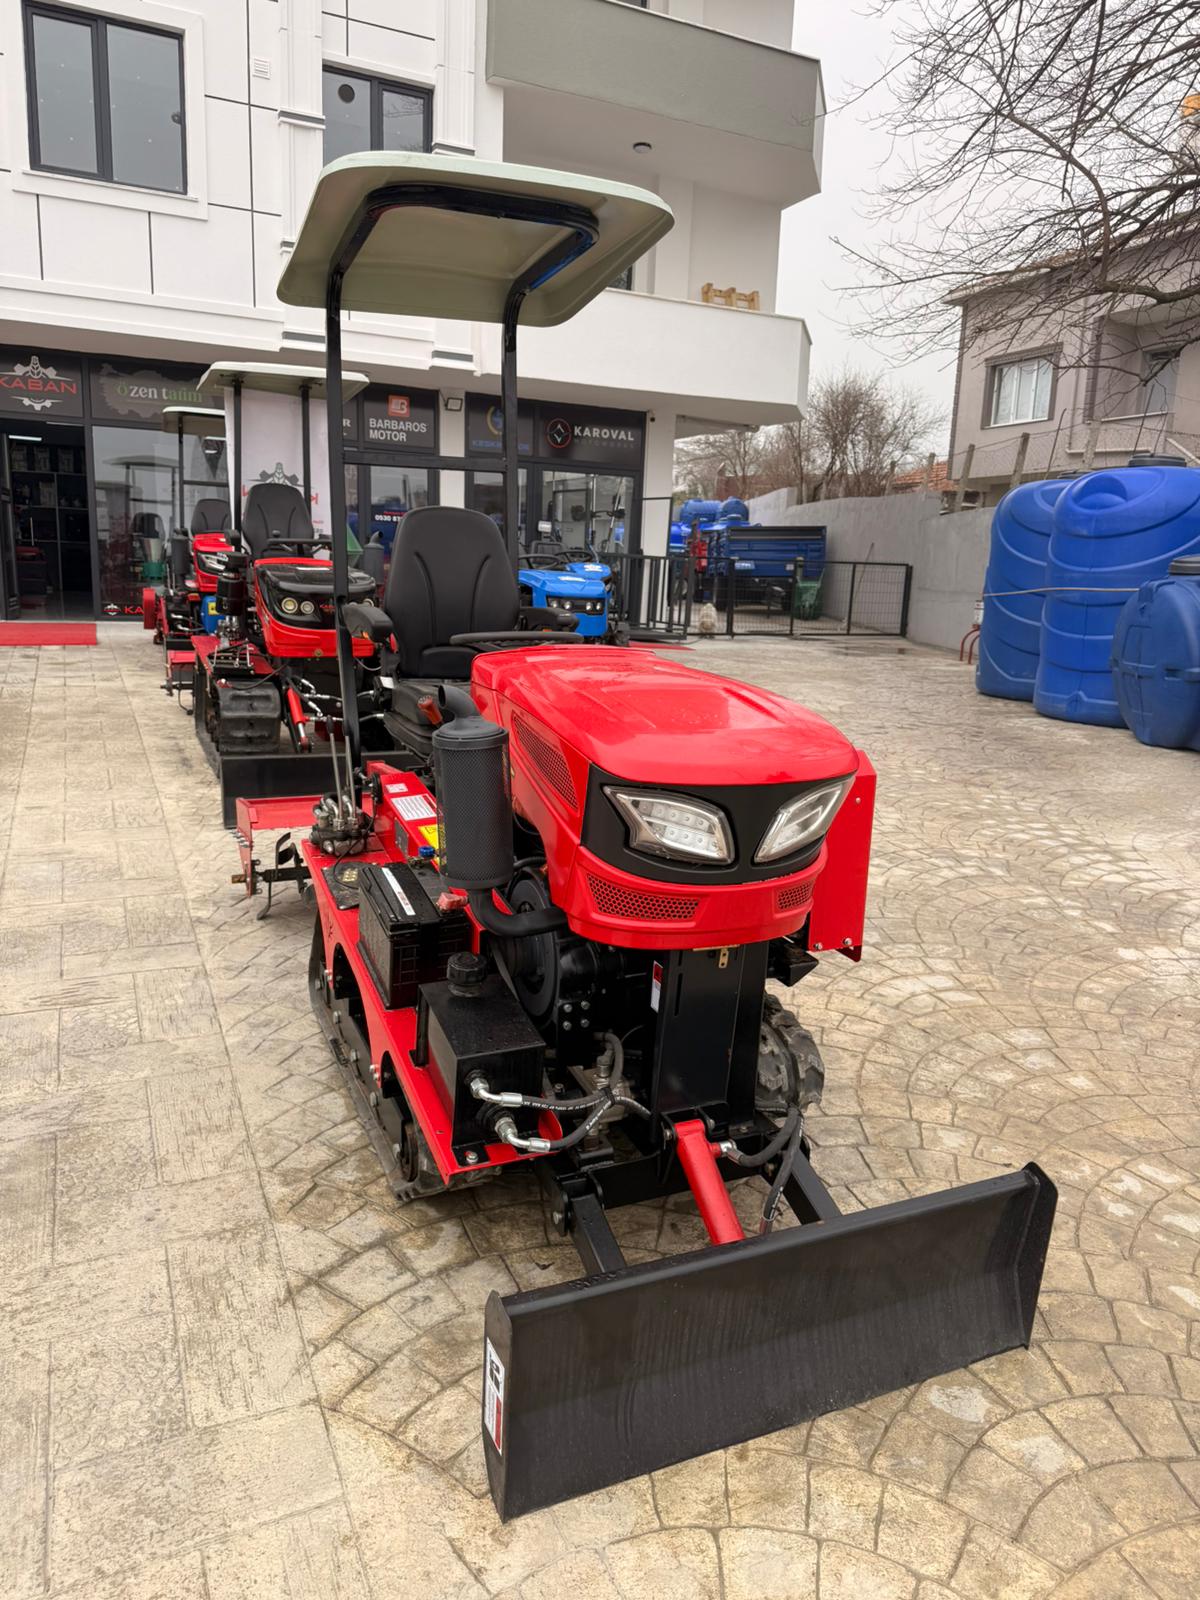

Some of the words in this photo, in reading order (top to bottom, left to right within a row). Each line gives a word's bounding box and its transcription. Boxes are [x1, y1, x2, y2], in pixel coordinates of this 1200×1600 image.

[369, 418, 427, 433] BARBAROS
[369, 429, 407, 442] MOTOR
[574, 426, 634, 441] KAROVAL
